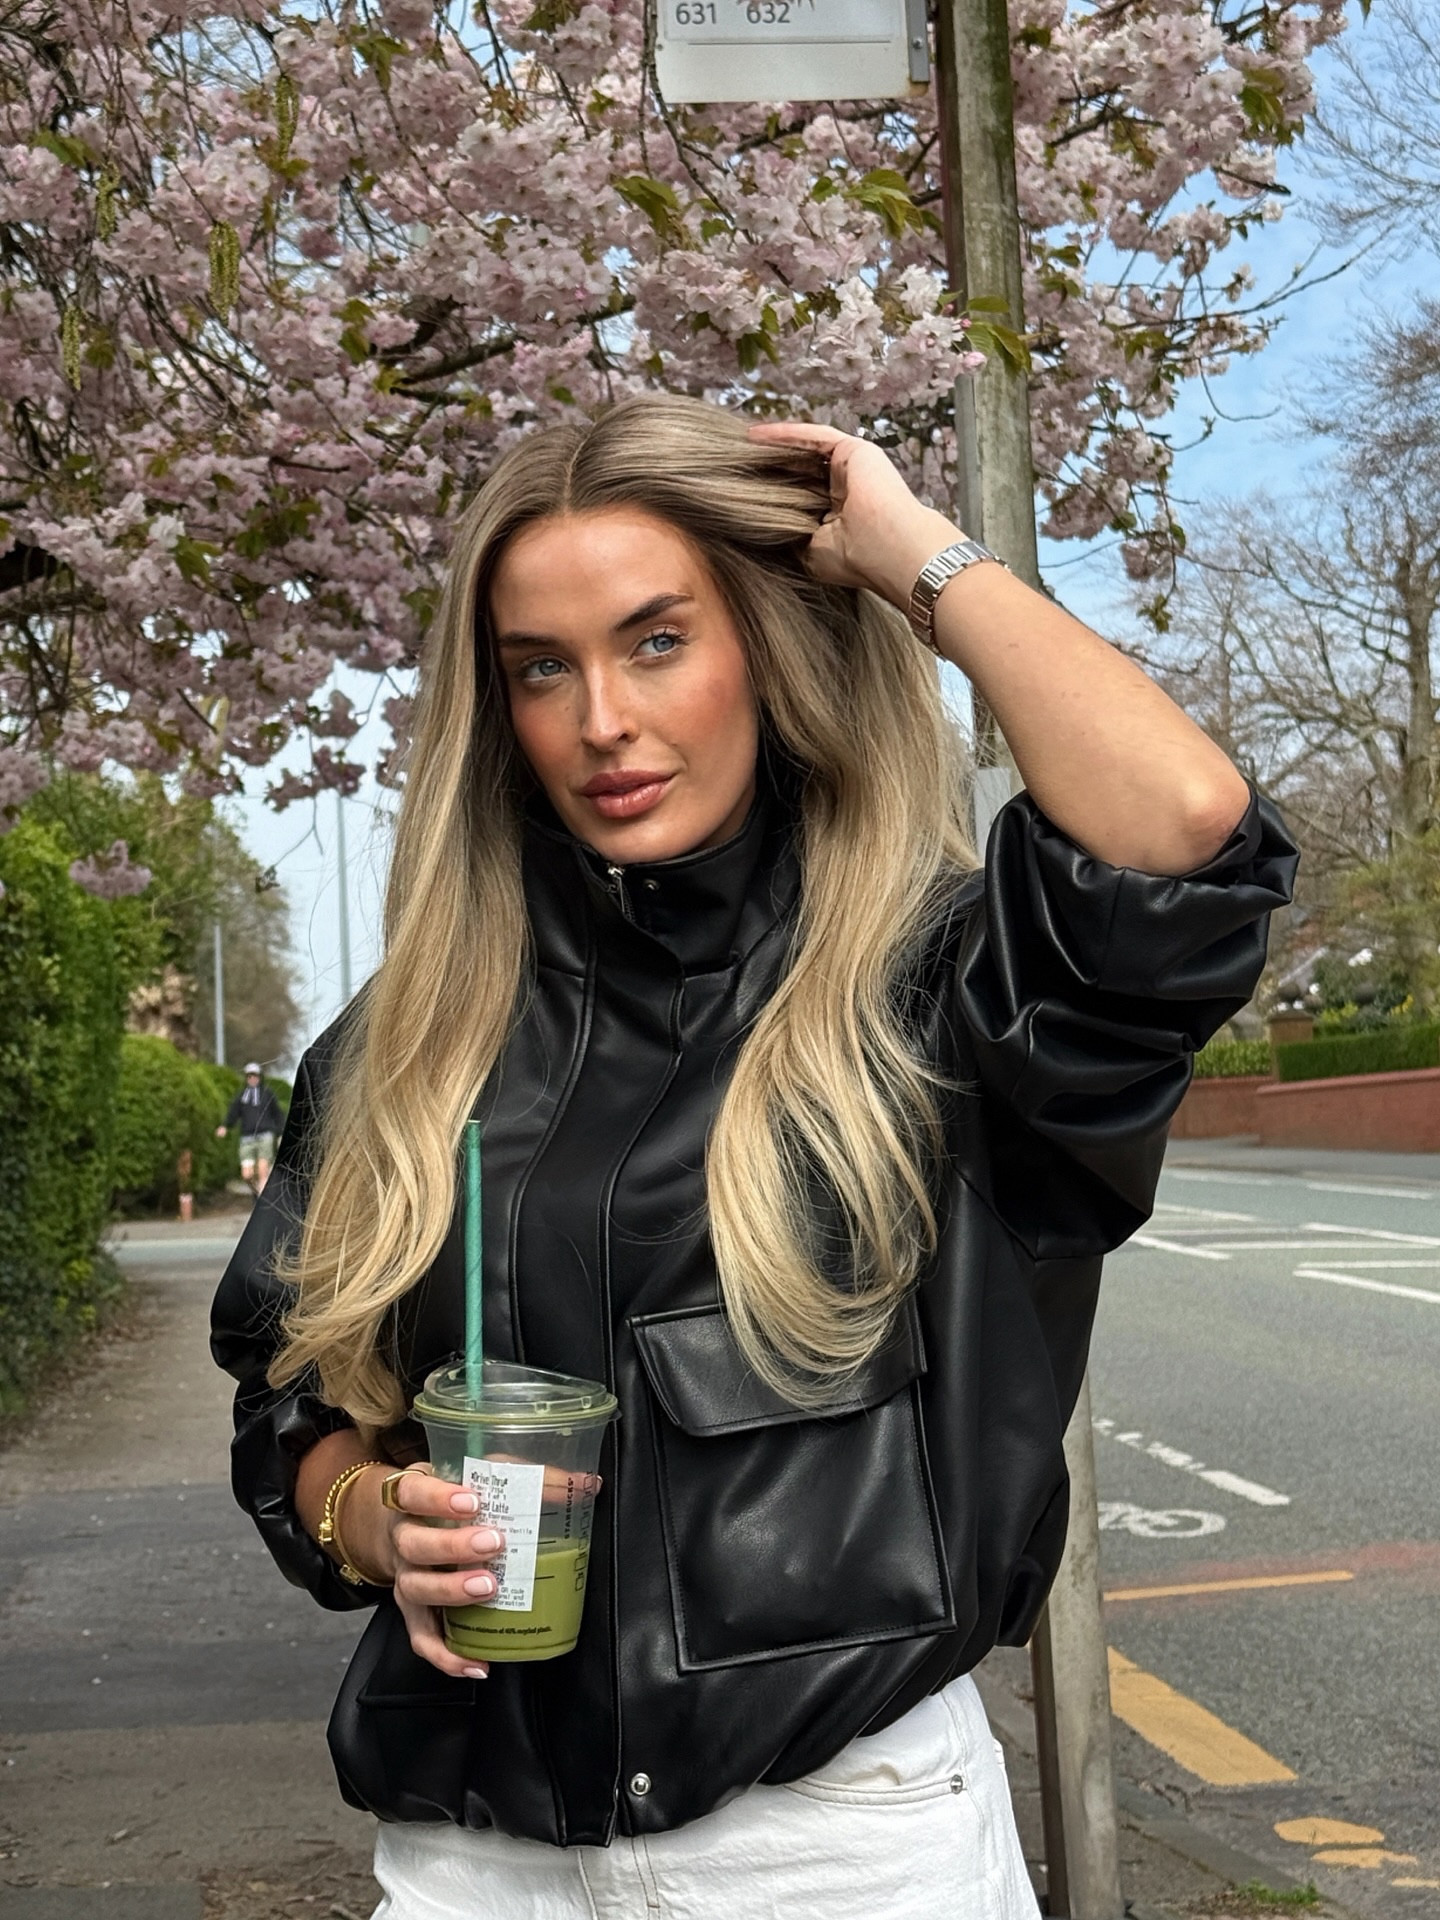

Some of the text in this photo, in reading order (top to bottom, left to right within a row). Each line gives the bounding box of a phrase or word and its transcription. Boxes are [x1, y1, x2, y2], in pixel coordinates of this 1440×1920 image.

[676, 2, 790, 25] 631 632
[491, 1501, 509, 1514] Latte
[564, 1479, 574, 1539] STARBUCKS
